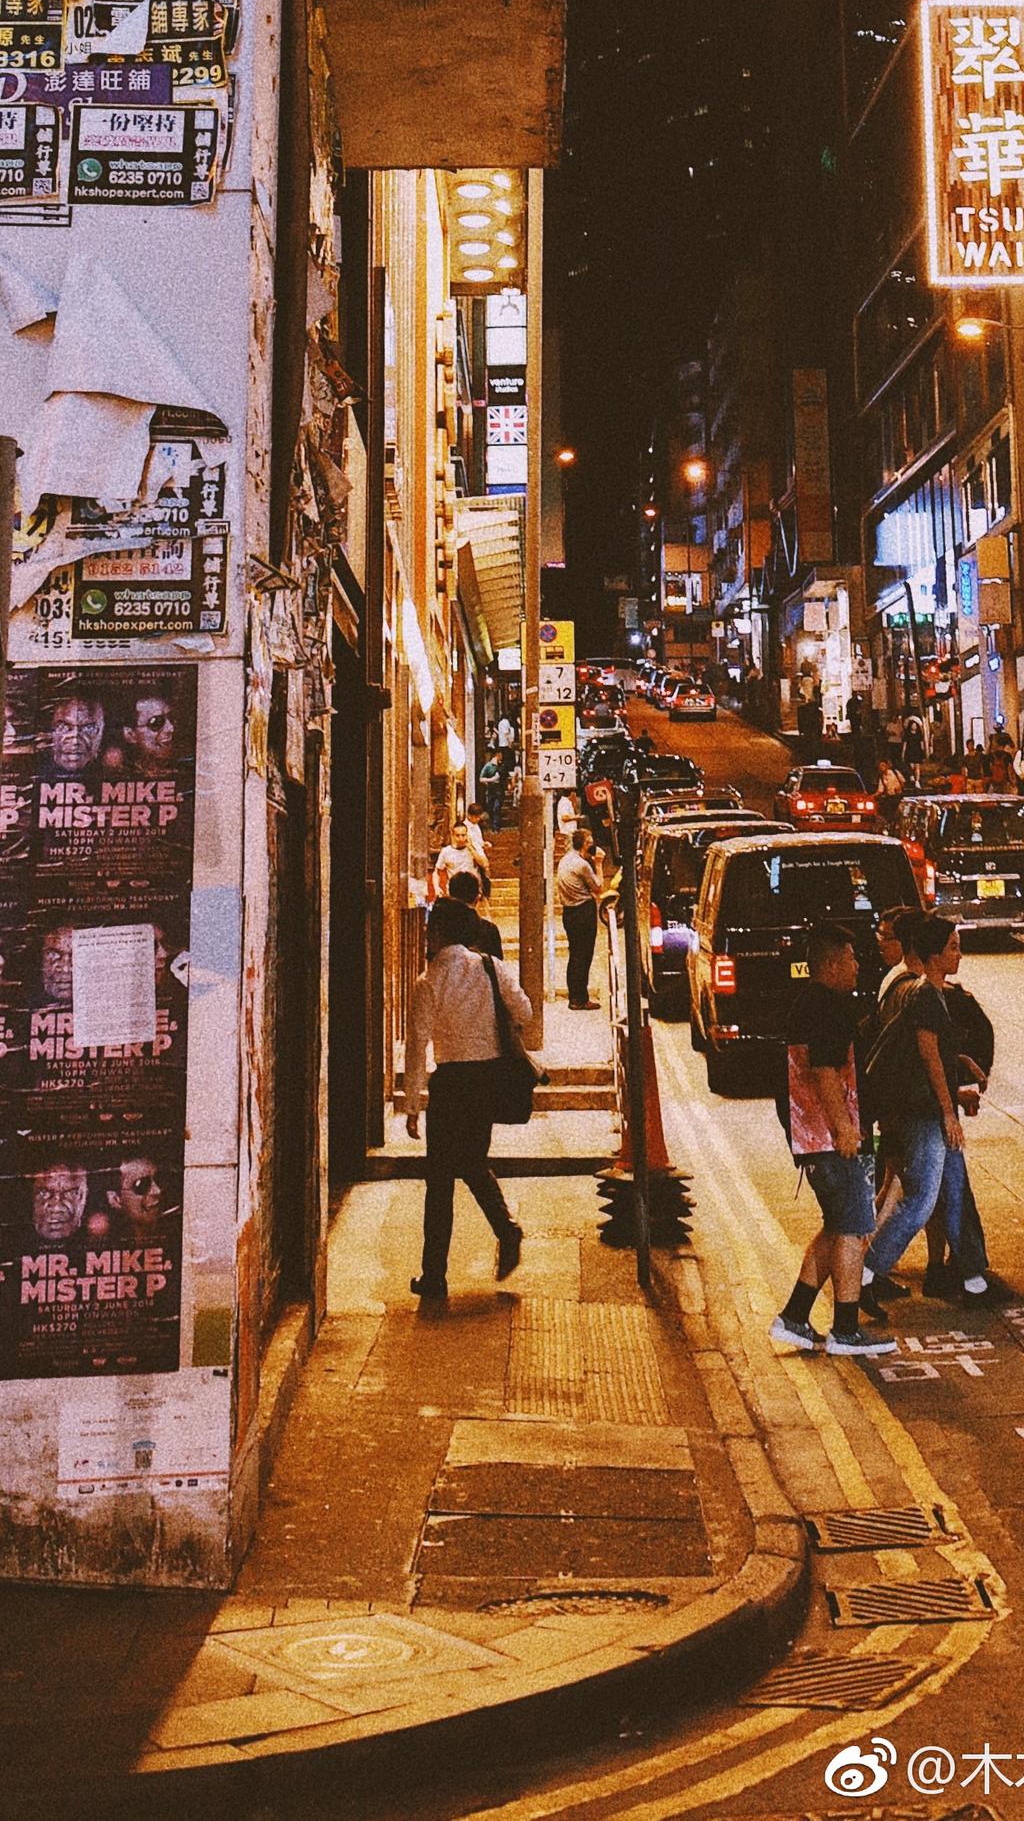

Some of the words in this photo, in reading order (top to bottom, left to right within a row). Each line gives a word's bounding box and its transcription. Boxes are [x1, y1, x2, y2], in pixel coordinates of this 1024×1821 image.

[108, 171, 145, 185] 6235
[149, 171, 183, 185] 0710
[74, 186, 185, 200] hkshopexpert.com
[113, 601, 151, 616] 6235
[154, 601, 191, 616] 0710
[78, 619, 194, 633] hkshopexpert.com
[555, 666, 564, 679] 7
[556, 687, 572, 700] 12
[544, 754, 573, 766] 7-10
[543, 772, 566, 783] 4-7
[38, 805, 151, 828] MISTER
[158, 804, 178, 826] P
[55, 829, 106, 838] SATURDAY
[46, 1060, 98, 1070] SATURDAY
[22, 1253, 78, 1278] MR.
[20, 1276, 139, 1305] MISTER
[146, 1273, 167, 1298] P
